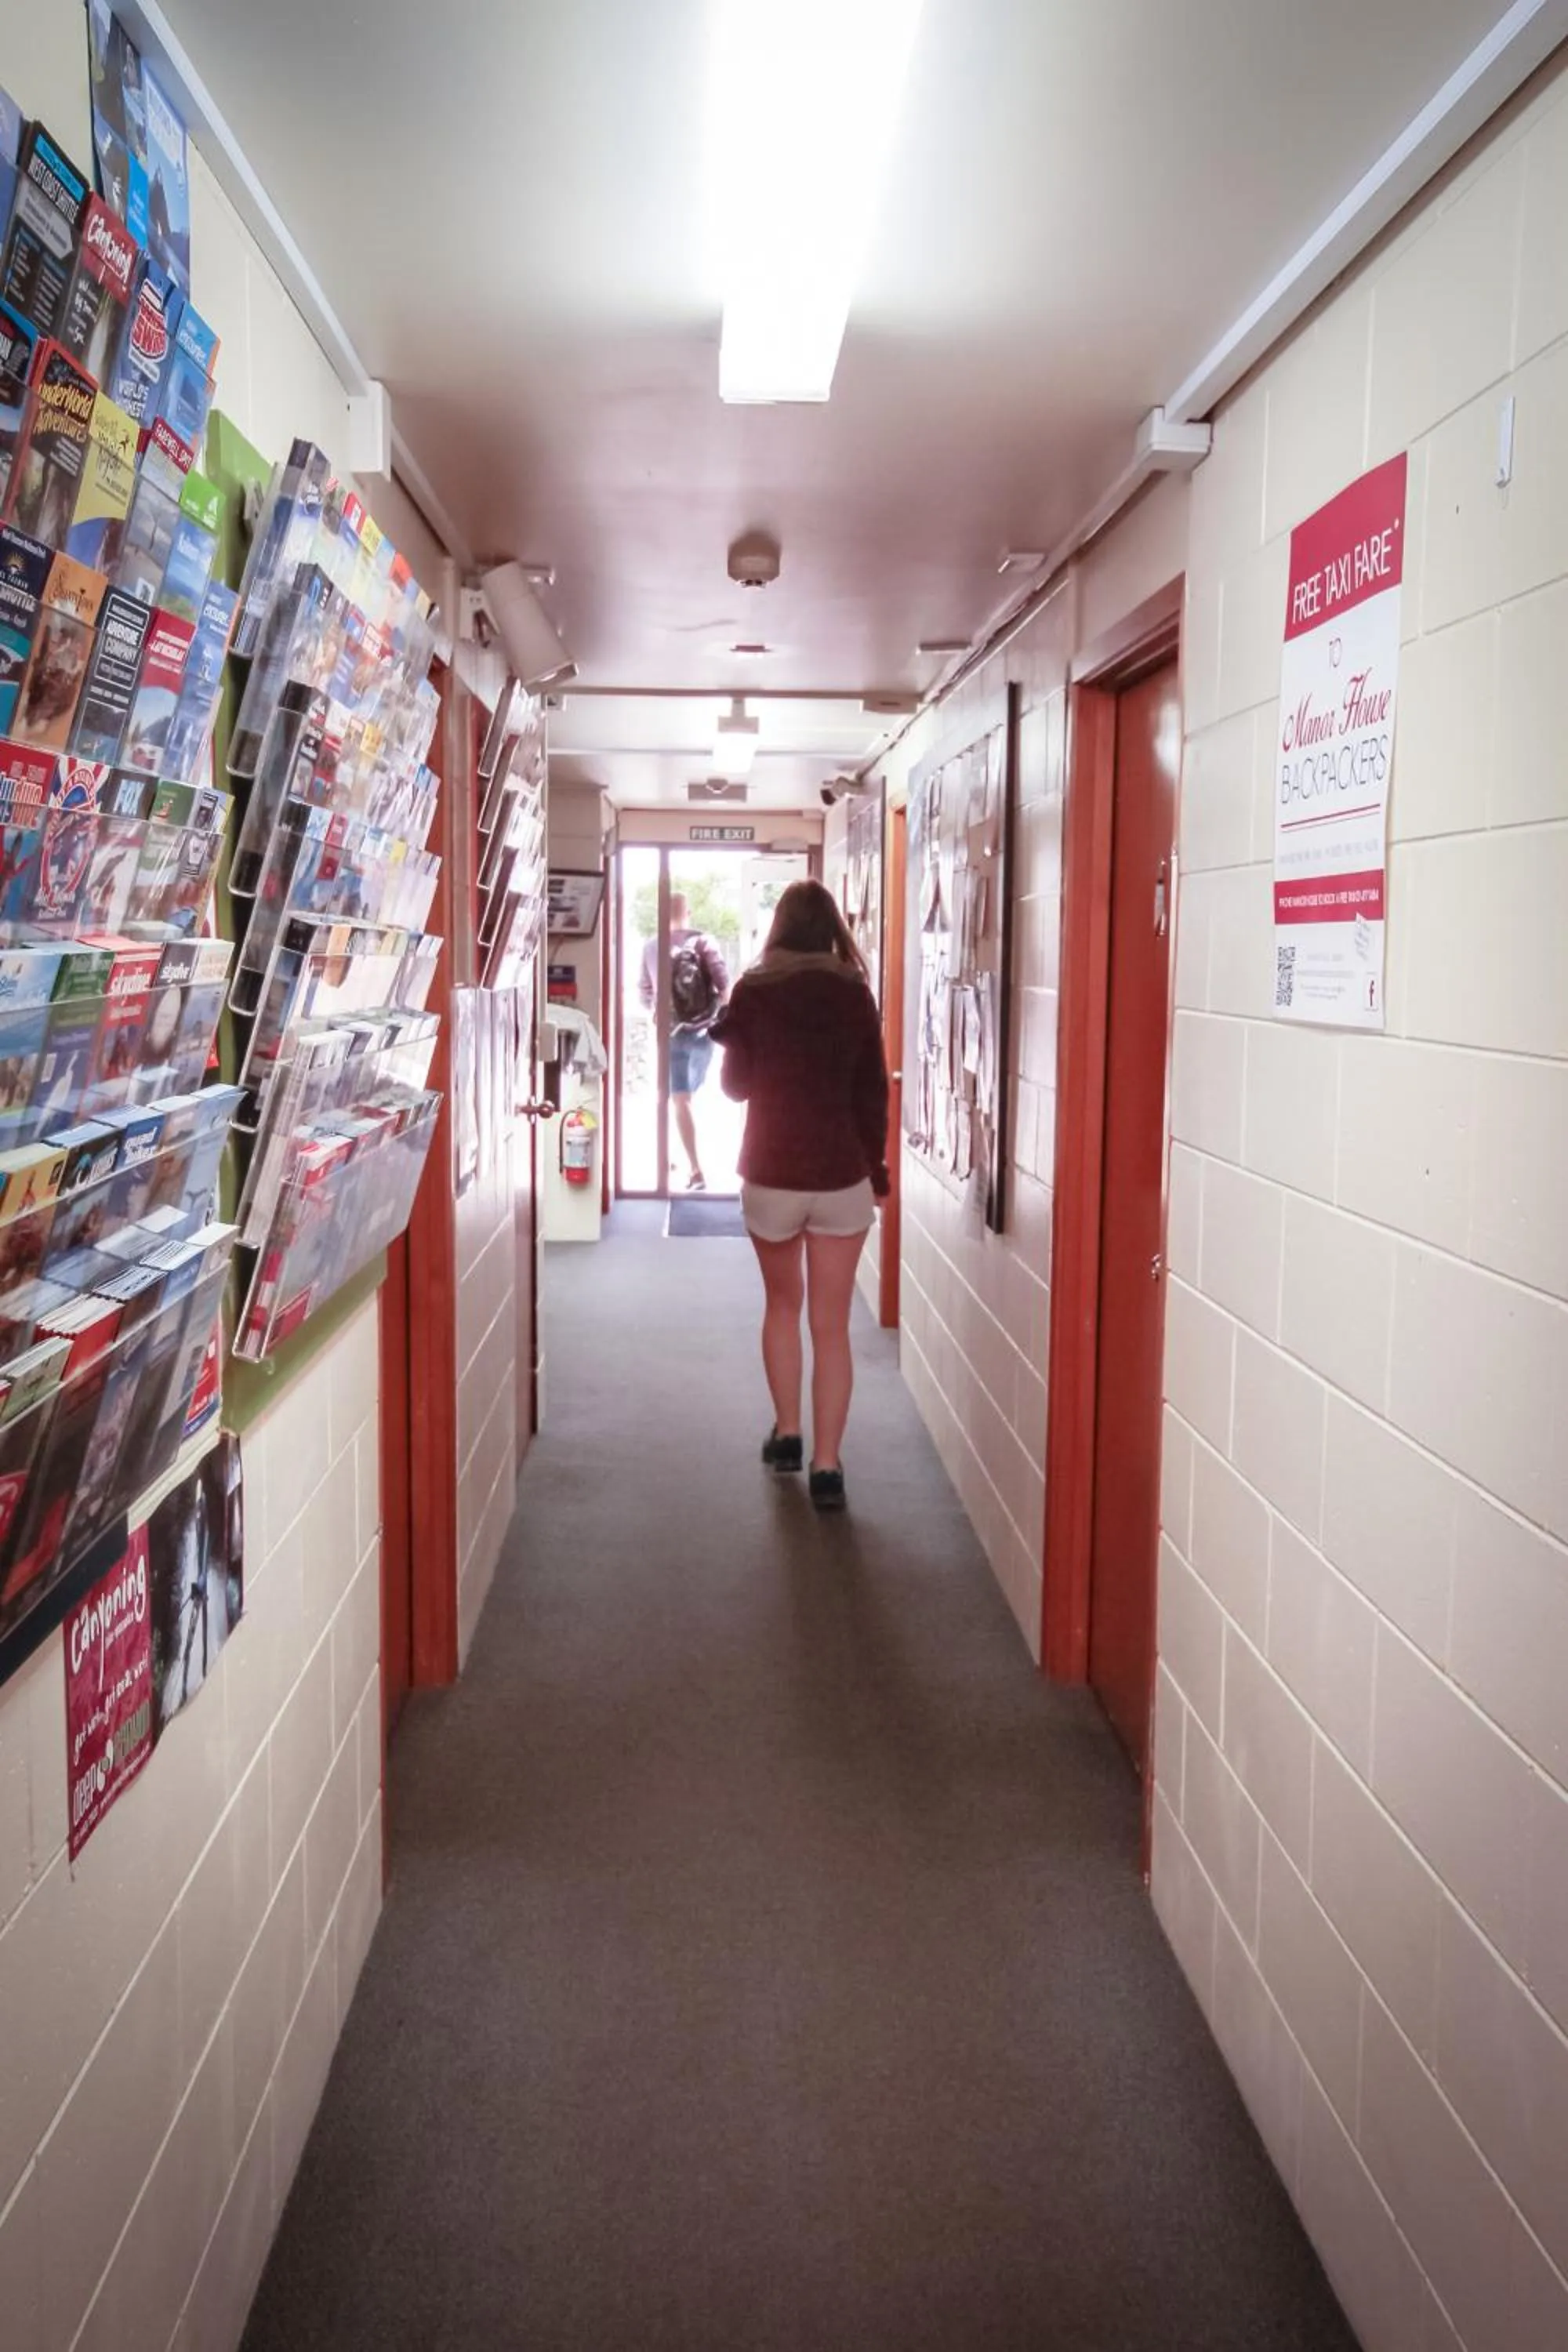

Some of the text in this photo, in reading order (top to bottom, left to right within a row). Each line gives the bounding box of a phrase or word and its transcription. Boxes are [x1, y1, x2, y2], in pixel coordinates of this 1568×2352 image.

[1292, 572, 1322, 625] FREE
[1324, 552, 1352, 608] TAXI
[1283, 666, 1392, 753] Manor House
[1281, 734, 1388, 804] BACKPACKERS
[71, 1555, 146, 1693] Canyoning
